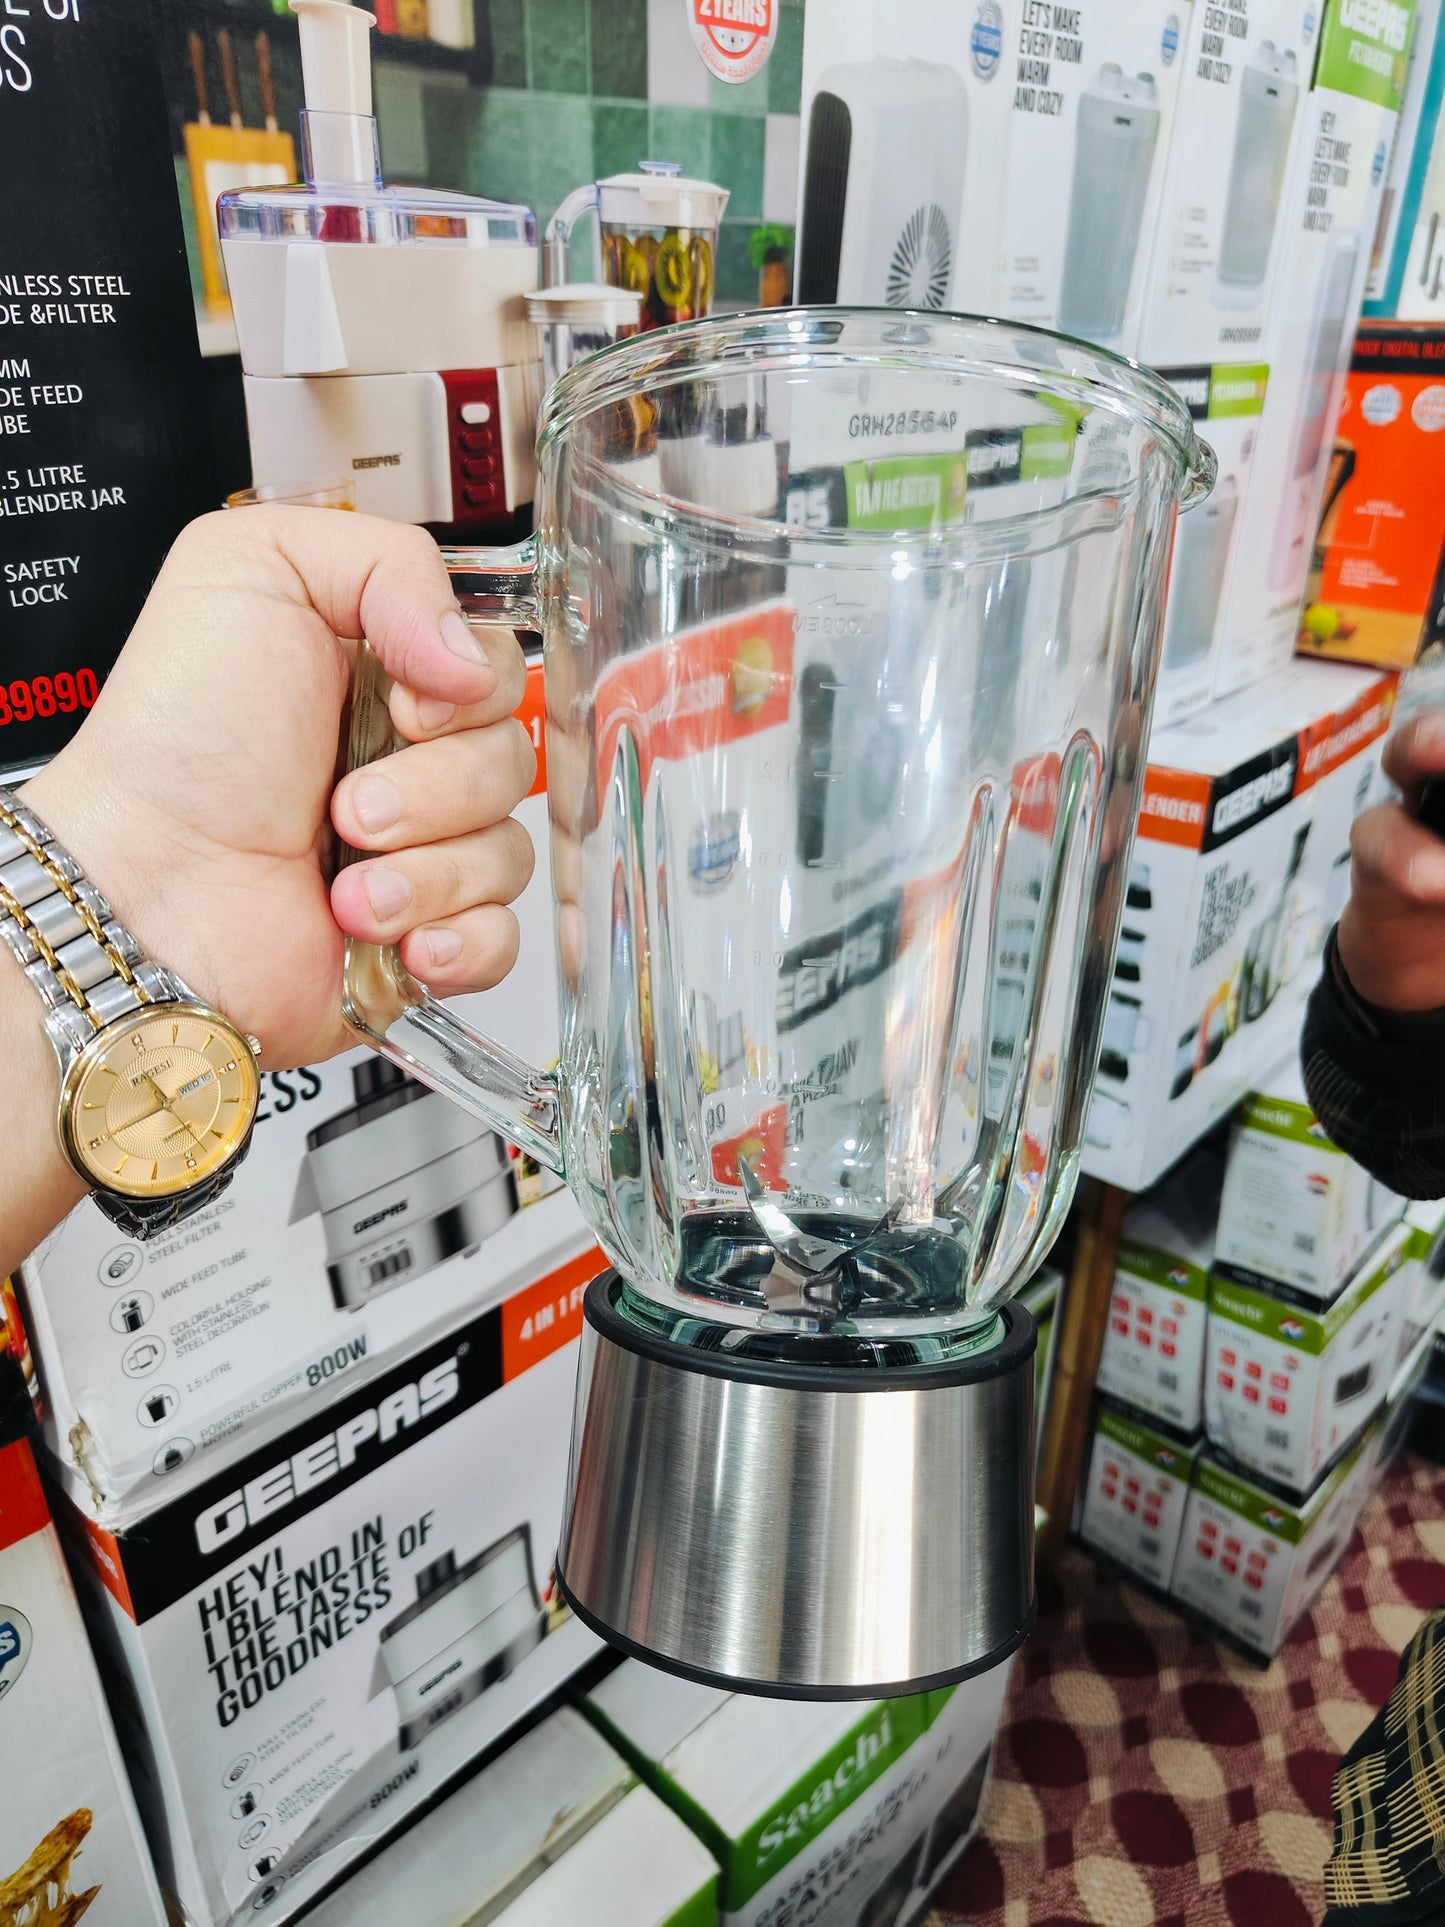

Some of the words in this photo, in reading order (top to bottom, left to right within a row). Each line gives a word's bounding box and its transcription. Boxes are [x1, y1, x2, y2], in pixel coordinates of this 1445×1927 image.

[1019, 28, 1054, 58] EVERY
[1012, 86, 1036, 113] AND
[68, 274, 131, 297] STEEL
[29, 302, 117, 325] &FILTER
[30, 383, 84, 406] FEED
[27, 464, 87, 488] LITRE
[352, 454, 402, 470] GEEPAS
[90, 486, 127, 511] JAR
[4, 555, 81, 583] SAFETY
[10, 583, 69, 607] LOCK
[1212, 757, 1296, 835] GEEPAS
[180, 1079, 200, 1096] WED
[175, 1199, 236, 1235] STAINLESS
[353, 1199, 409, 1235] GEEPAS
[148, 1240, 185, 1265] STEEL
[184, 1220, 222, 1246] FILTER
[161, 1278, 191, 1300] WIDE
[191, 1263, 220, 1284] FEED
[220, 1247, 249, 1268] TUBE
[225, 1276, 273, 1306] HOUSING
[172, 1324, 202, 1347] WITH
[200, 1297, 255, 1332] STAINLESS
[176, 1335, 206, 1359] STEEL
[206, 1300, 271, 1342] DECORATION
[519, 1316, 534, 1340] 4
[534, 1302, 555, 1335] IN
[557, 1294, 567, 1318] 1
[200, 1398, 258, 1441] POWERFUL
[261, 1370, 304, 1404] COPPER
[305, 1333, 368, 1388] 800W
[204, 1359, 233, 1384] LITRE
[194, 1354, 460, 1557] GEEPAS
[198, 1545, 285, 1632] HEY!
[204, 1629, 217, 1666] I
[226, 1544, 342, 1650] BLEND
[352, 1513, 385, 1562] IN
[207, 1620, 280, 1694] THE
[287, 1541, 389, 1636] TASTE
[398, 1508, 435, 1559] OF
[216, 1572, 393, 1728] GOODNESS
[368, 1758, 419, 1809] 800W
